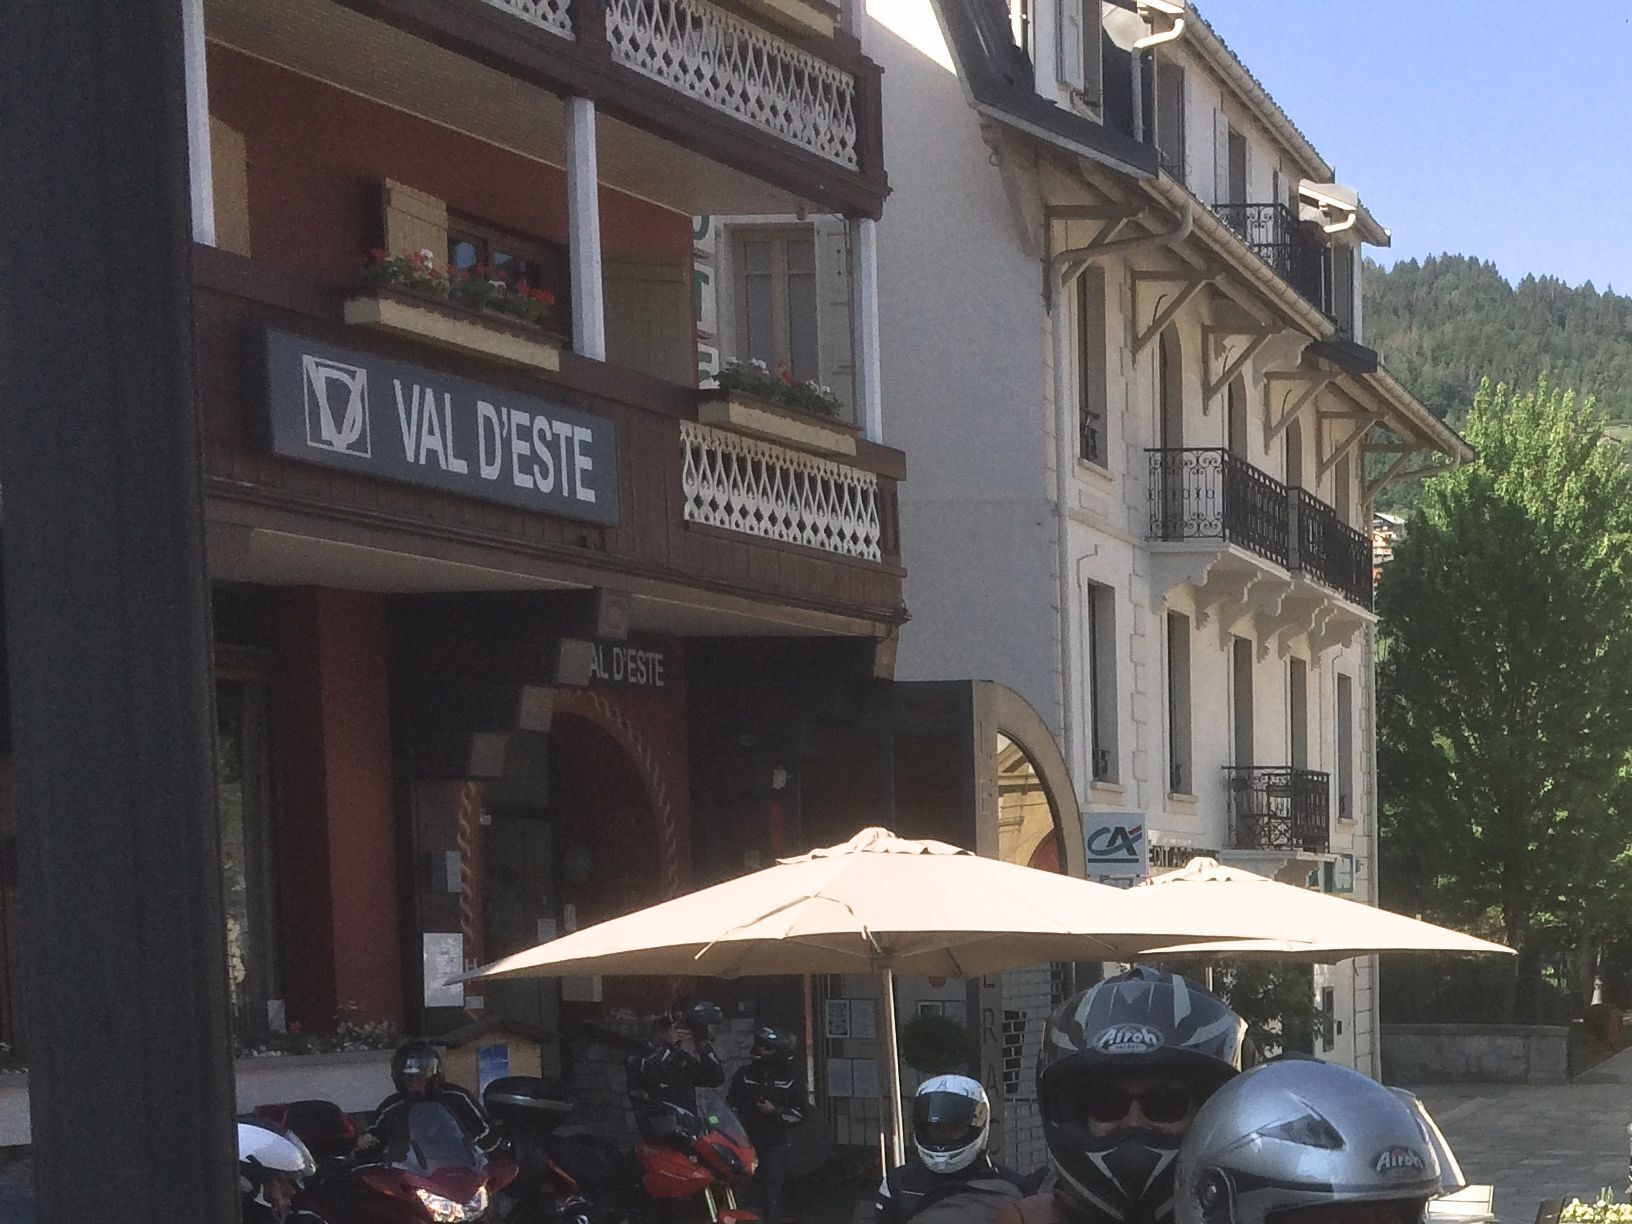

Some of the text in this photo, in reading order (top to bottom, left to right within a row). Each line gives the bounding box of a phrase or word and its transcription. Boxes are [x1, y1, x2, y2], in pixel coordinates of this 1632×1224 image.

[394, 379, 595, 503] VAL D'ESTE
[588, 641, 664, 687] AL D'ESTE
[1098, 1027, 1157, 1047] Airoh
[1376, 1150, 1423, 1172] Airoh
